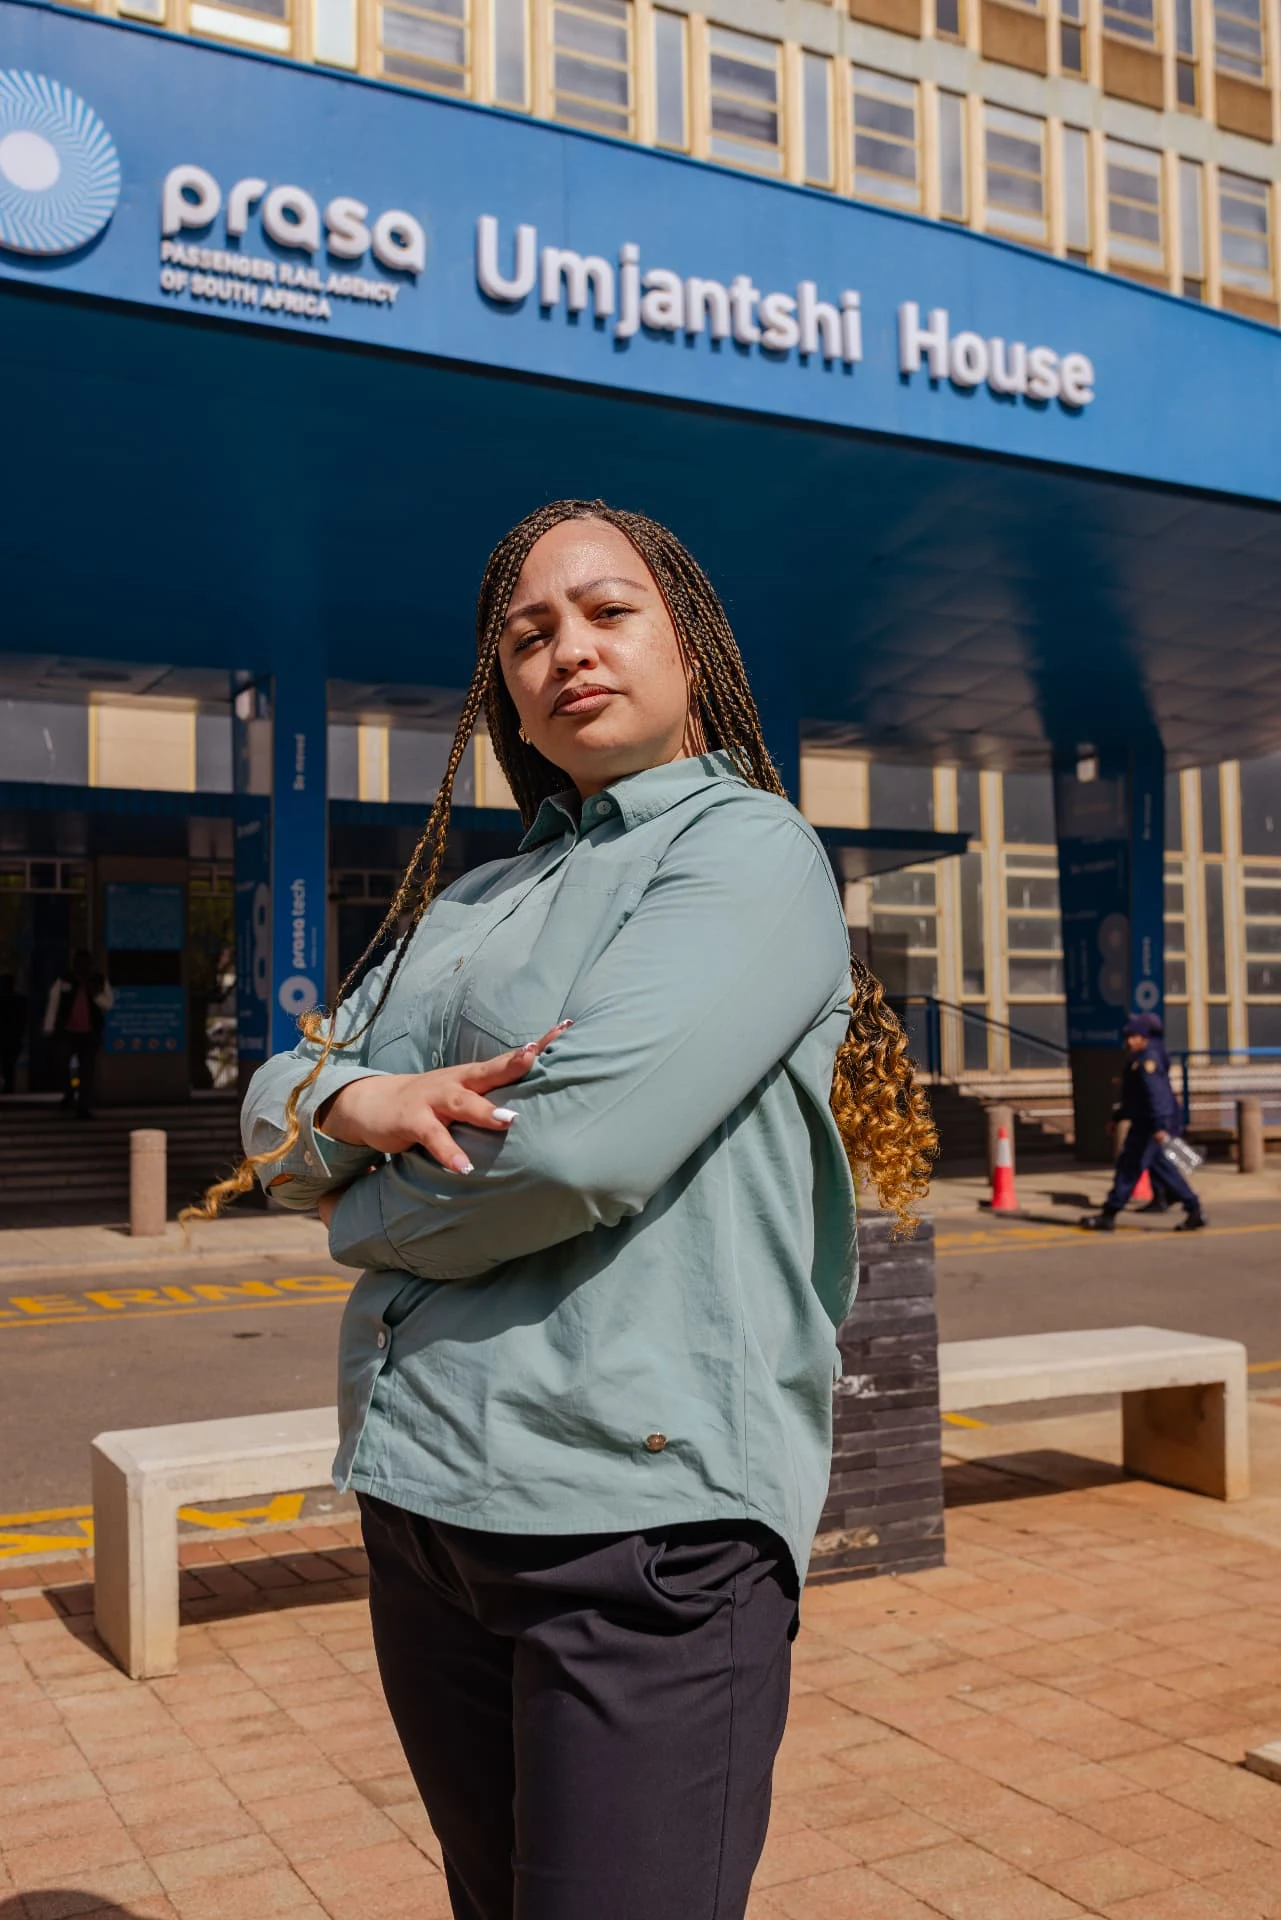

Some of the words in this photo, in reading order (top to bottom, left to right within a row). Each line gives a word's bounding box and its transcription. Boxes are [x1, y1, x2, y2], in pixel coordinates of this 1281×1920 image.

[163, 164, 426, 274] prasa
[161, 241, 276, 283] PASSENGER
[279, 264, 323, 291] RAIL
[325, 273, 399, 303] AGENCY
[161, 269, 188, 292] OF
[191, 275, 258, 305] SOUTH
[261, 286, 332, 319] AFRICA
[477, 215, 862, 364] Umjantshi
[898, 301, 1096, 408] House
[292, 918, 307, 969] prasa
[0, 1275, 354, 1318] ERING
